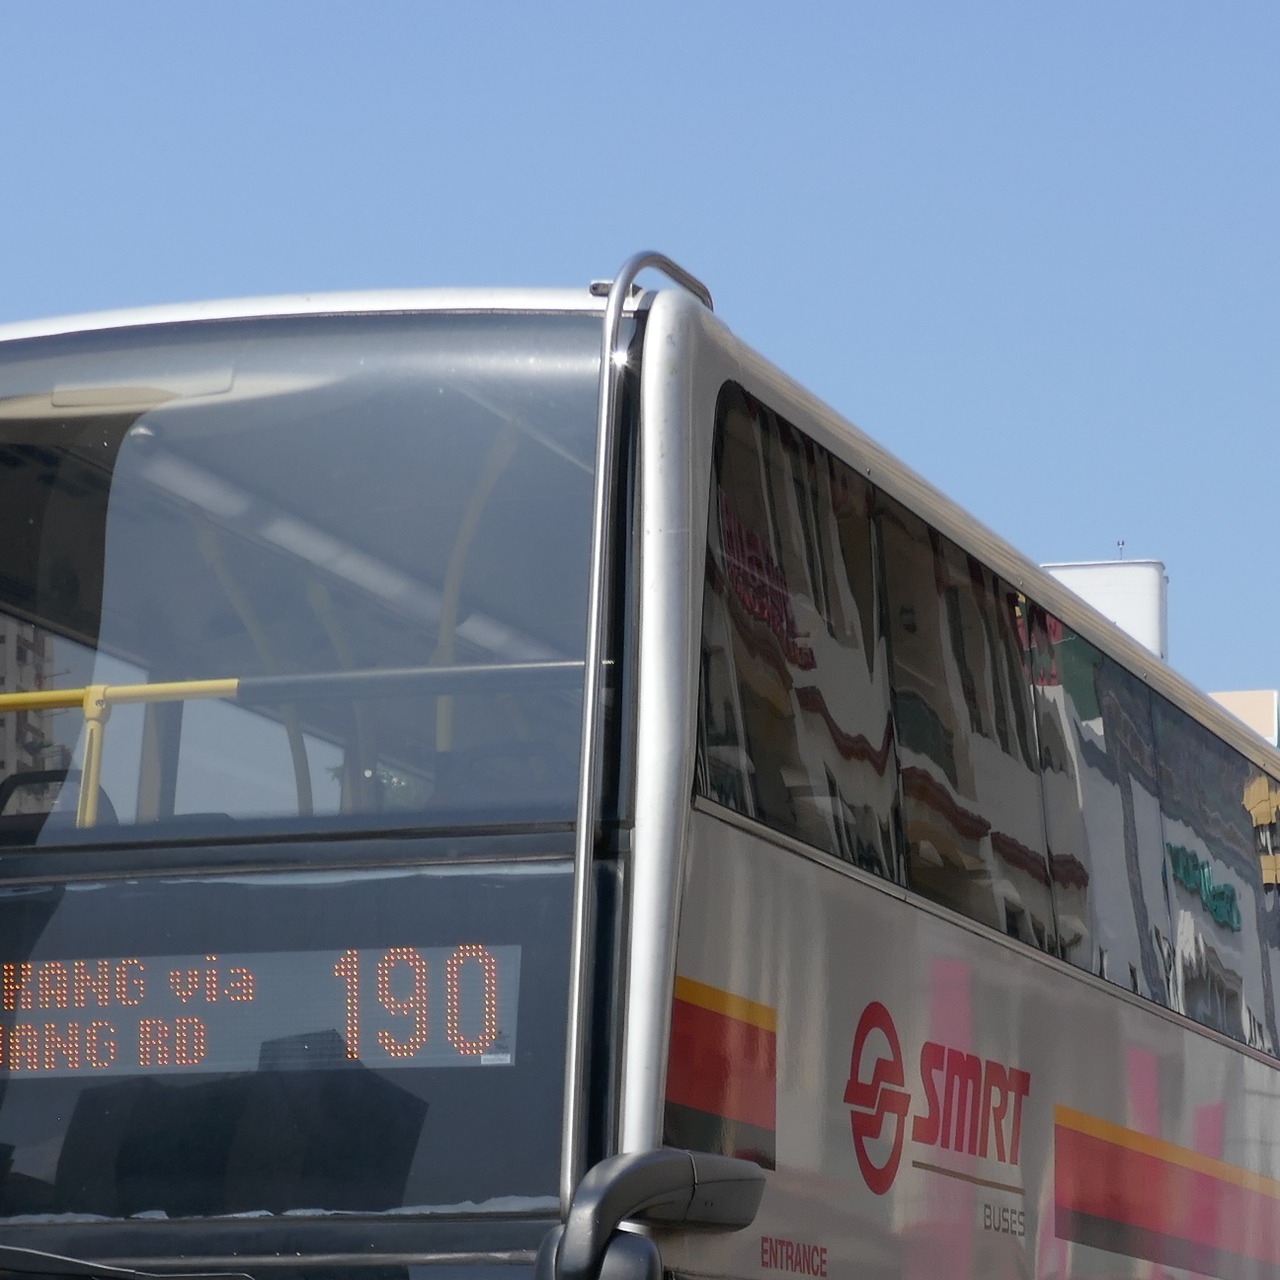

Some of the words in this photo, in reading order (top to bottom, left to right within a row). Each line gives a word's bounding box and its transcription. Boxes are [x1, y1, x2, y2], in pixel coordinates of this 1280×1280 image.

[3, 957, 146, 1010] KANG
[169, 953, 255, 1003] via
[333, 943, 497, 1060] 190
[138, 1016, 206, 1067] RD
[912, 1041, 1031, 1166] SMRT
[984, 1203, 1026, 1237] BUSES
[761, 1236, 828, 1278] ENTRANCE
